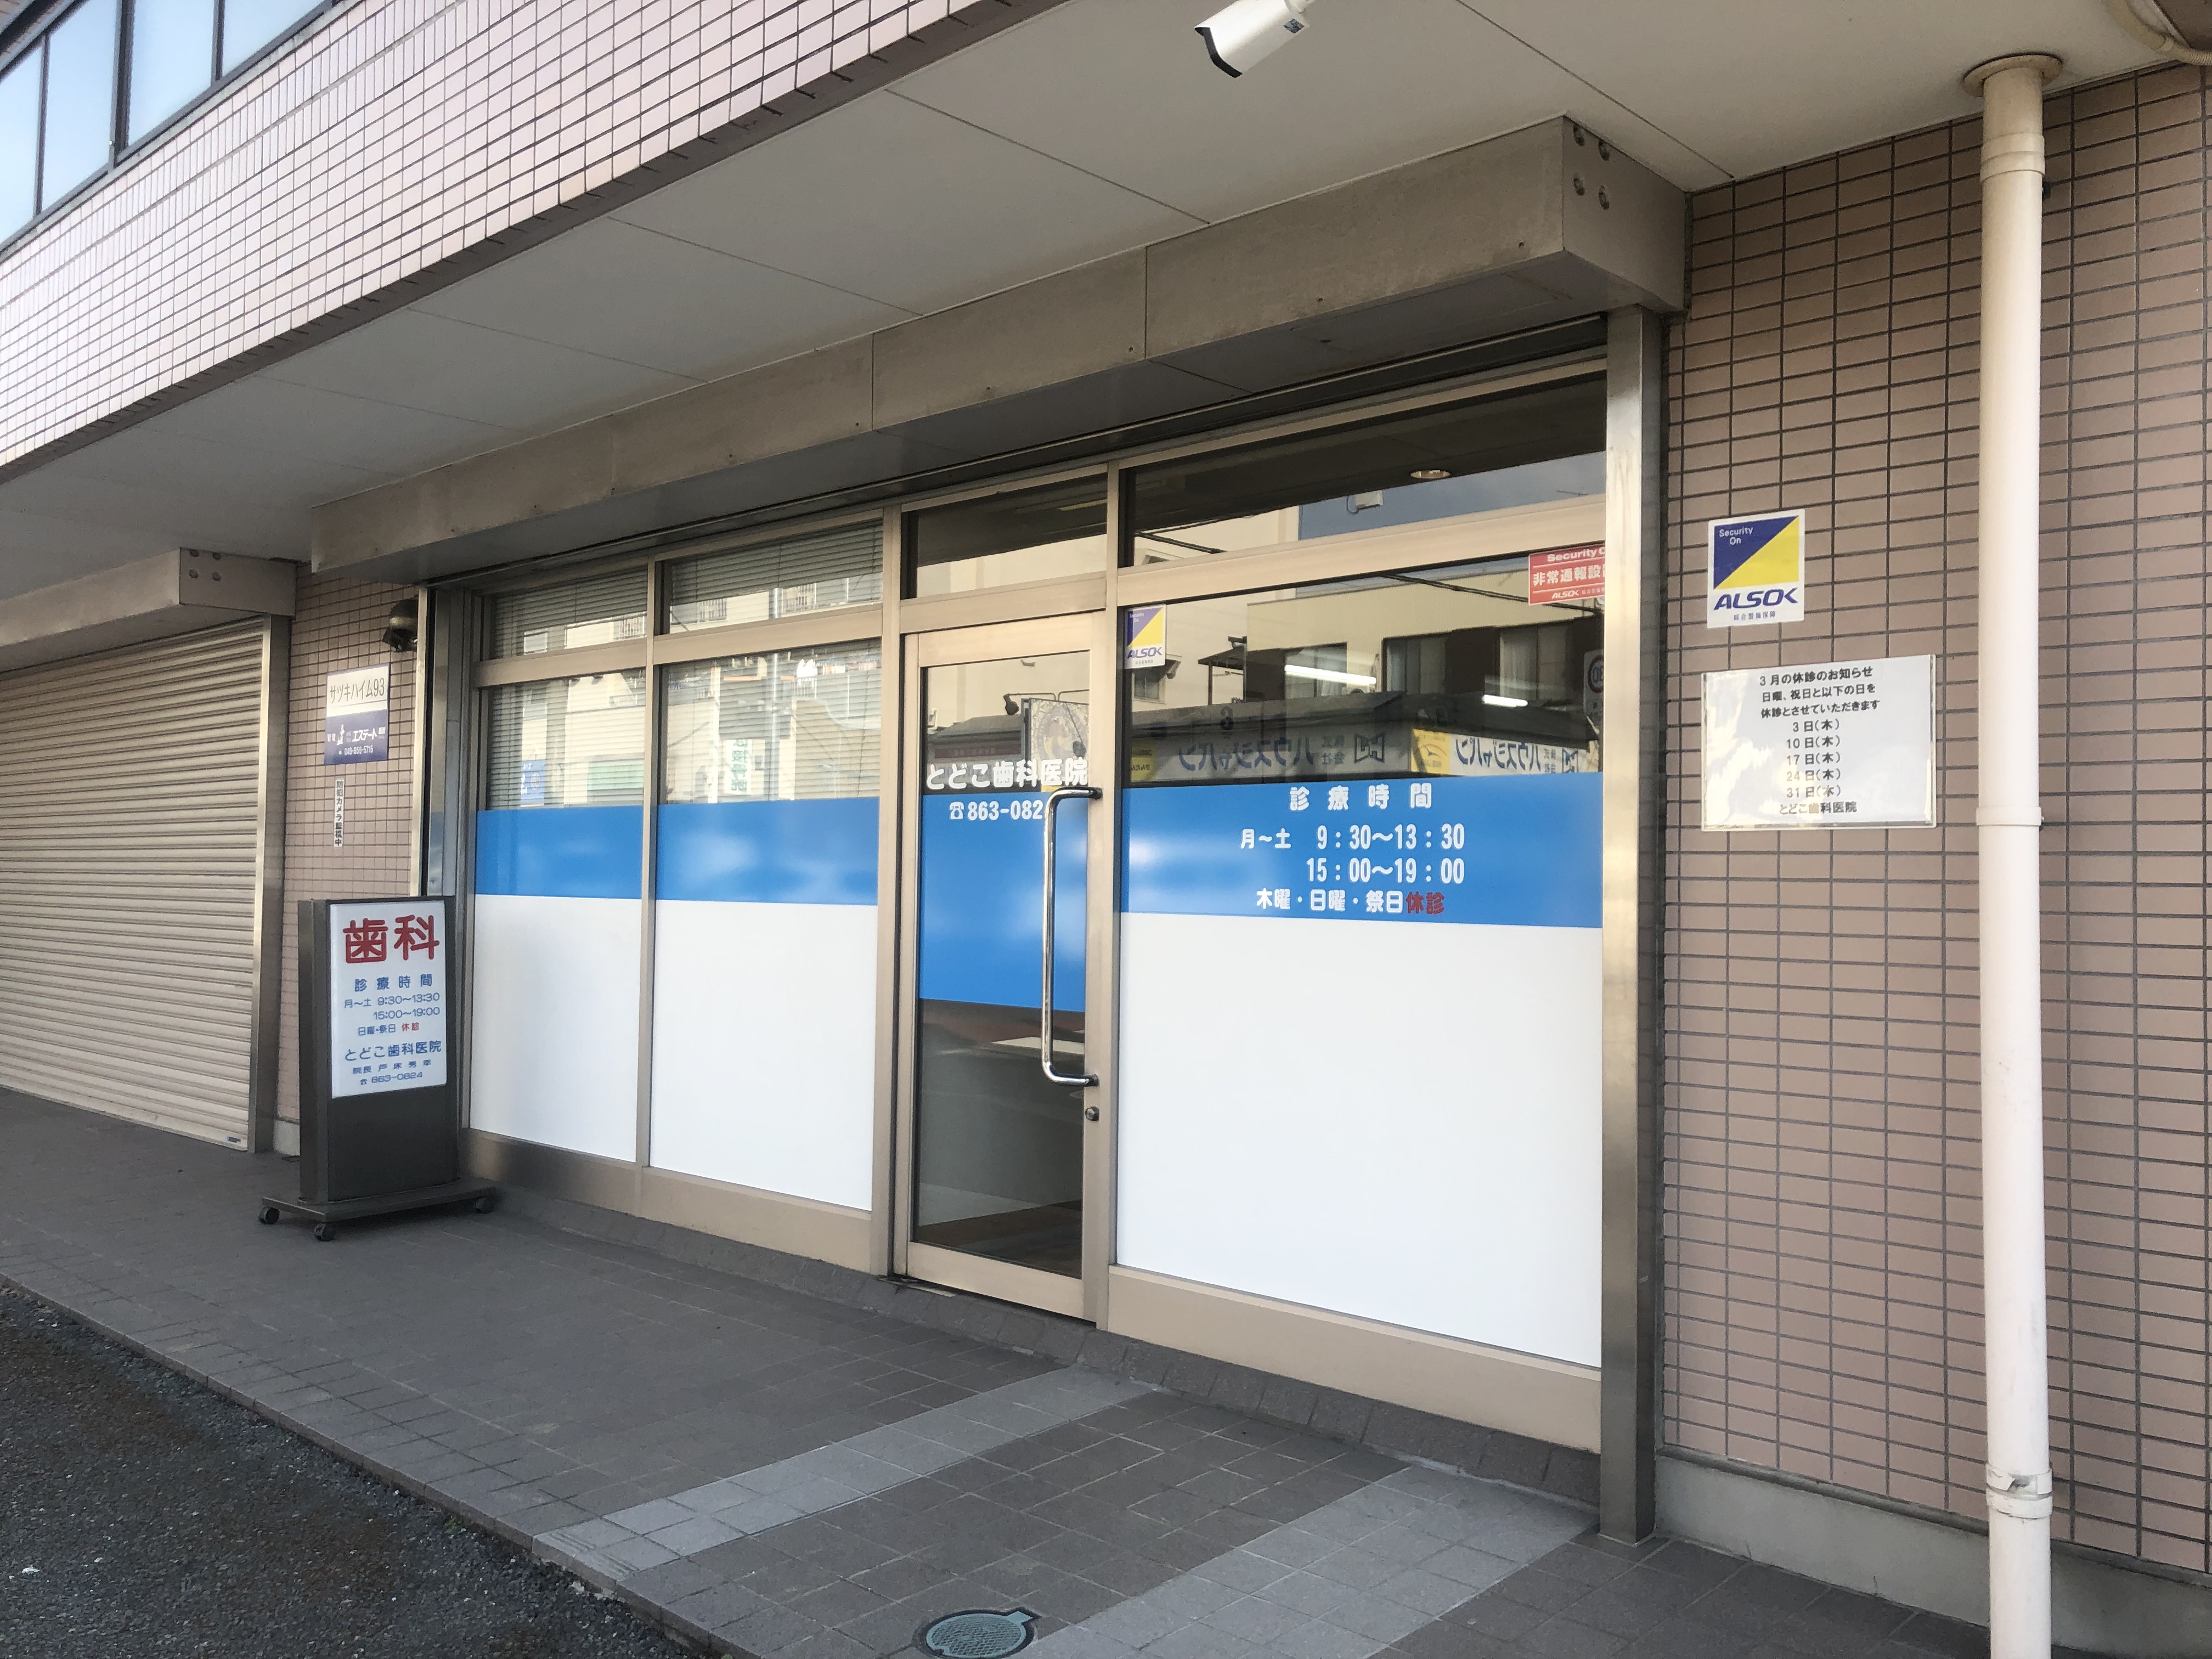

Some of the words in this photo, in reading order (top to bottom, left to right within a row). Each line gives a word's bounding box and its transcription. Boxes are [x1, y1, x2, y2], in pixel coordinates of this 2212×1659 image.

[1719, 527, 1753, 538] Security
[1729, 537, 1741, 545] On
[1547, 549, 1596, 562] Security
[1533, 563, 1606, 586] 非常通報設
[1551, 590, 1579, 599] ALSOK
[1713, 587, 1798, 610] ALSOK
[1127, 647, 1163, 659] ALSOK
[1759, 666, 1873, 686] 3月の休診のお知らせ
[330, 677, 385, 704] サツキハイム93
[1762, 684, 1876, 702] 日曜、祝日と以下の日を
[1761, 699, 1880, 719] 休診とさせていただきます
[927, 757, 1088, 790] とどこ歯科医院
[1289, 782, 1432, 811] 診療時間
[335, 781, 343, 846] 防犯カメラ監視中
[968, 799, 1043, 821] 863-082
[343, 915, 440, 963] 歯科
[354, 973, 432, 992] 診療時間
[401, 1022, 420, 1032] 休診
[345, 1040, 442, 1062] とどこ歯科医院
